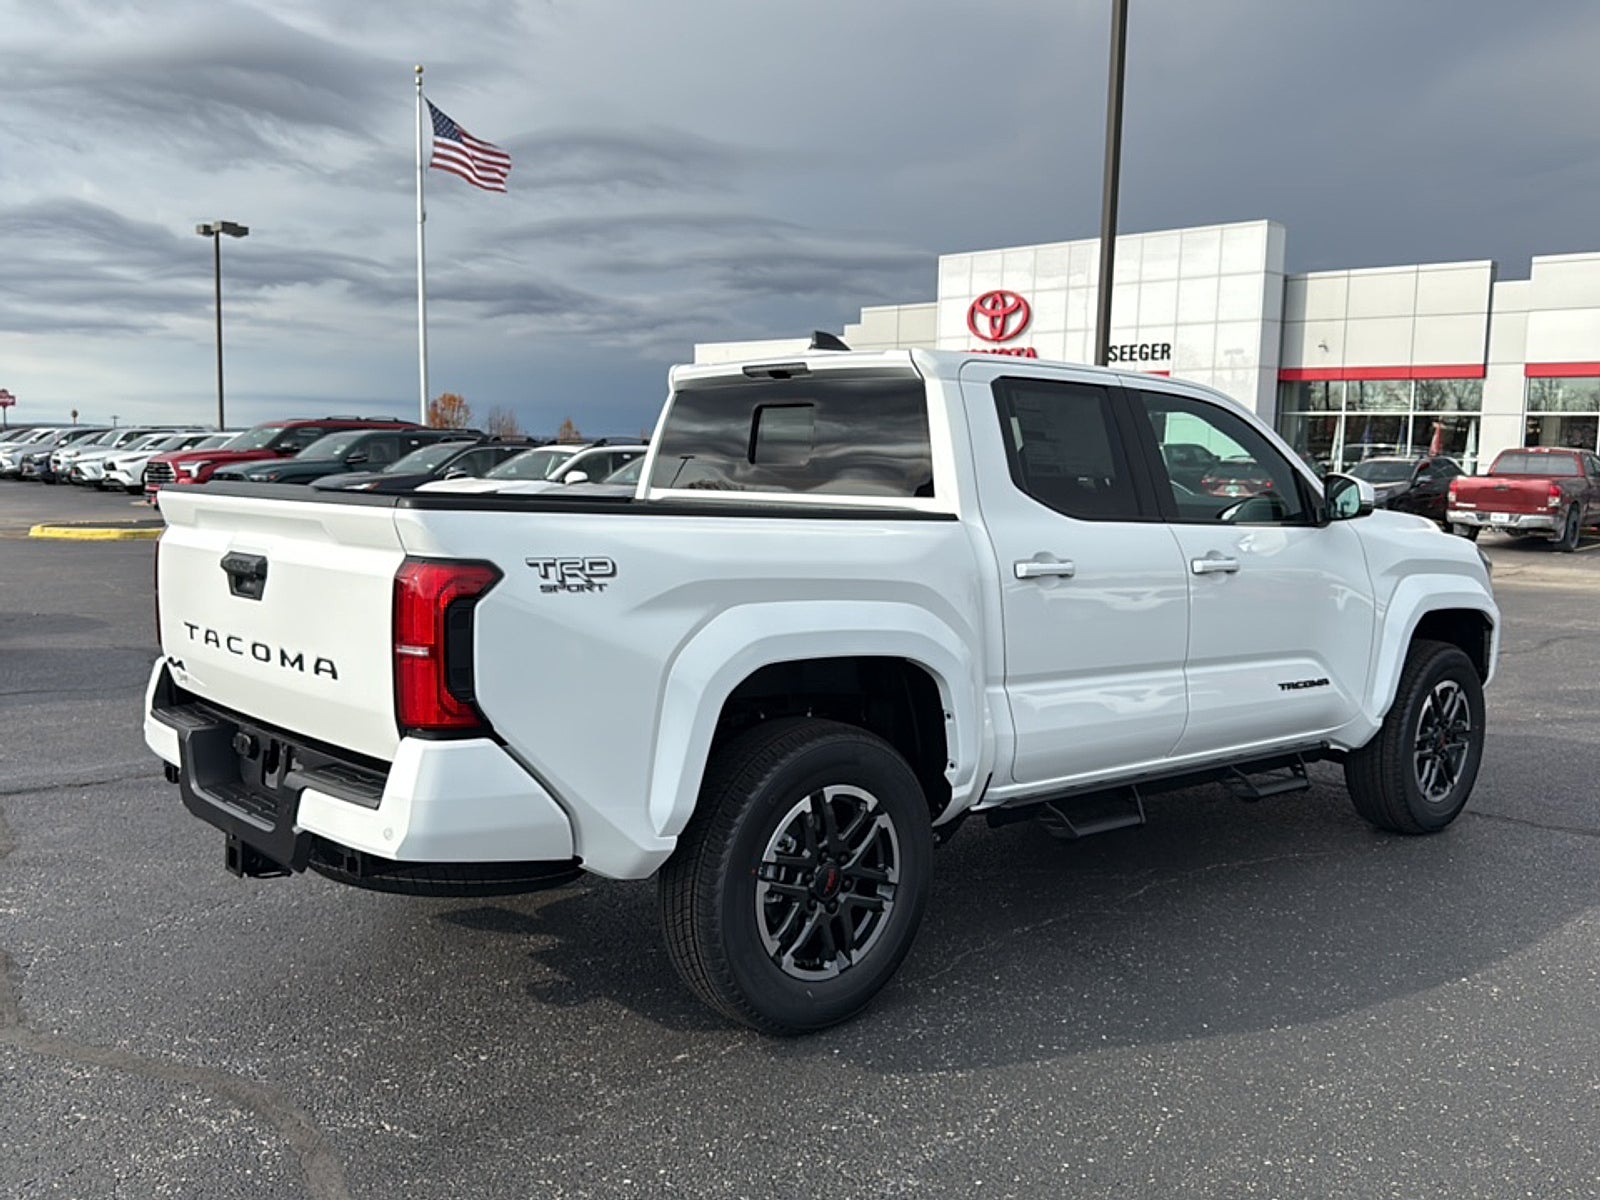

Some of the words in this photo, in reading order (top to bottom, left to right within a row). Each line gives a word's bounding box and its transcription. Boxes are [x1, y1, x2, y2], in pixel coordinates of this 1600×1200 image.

[1108, 343, 1172, 362] SEEGER
[525, 556, 618, 583] TRD
[540, 583, 608, 593] SPORT
[183, 621, 339, 681] TACOMA
[1277, 678, 1330, 691] TACOMA
